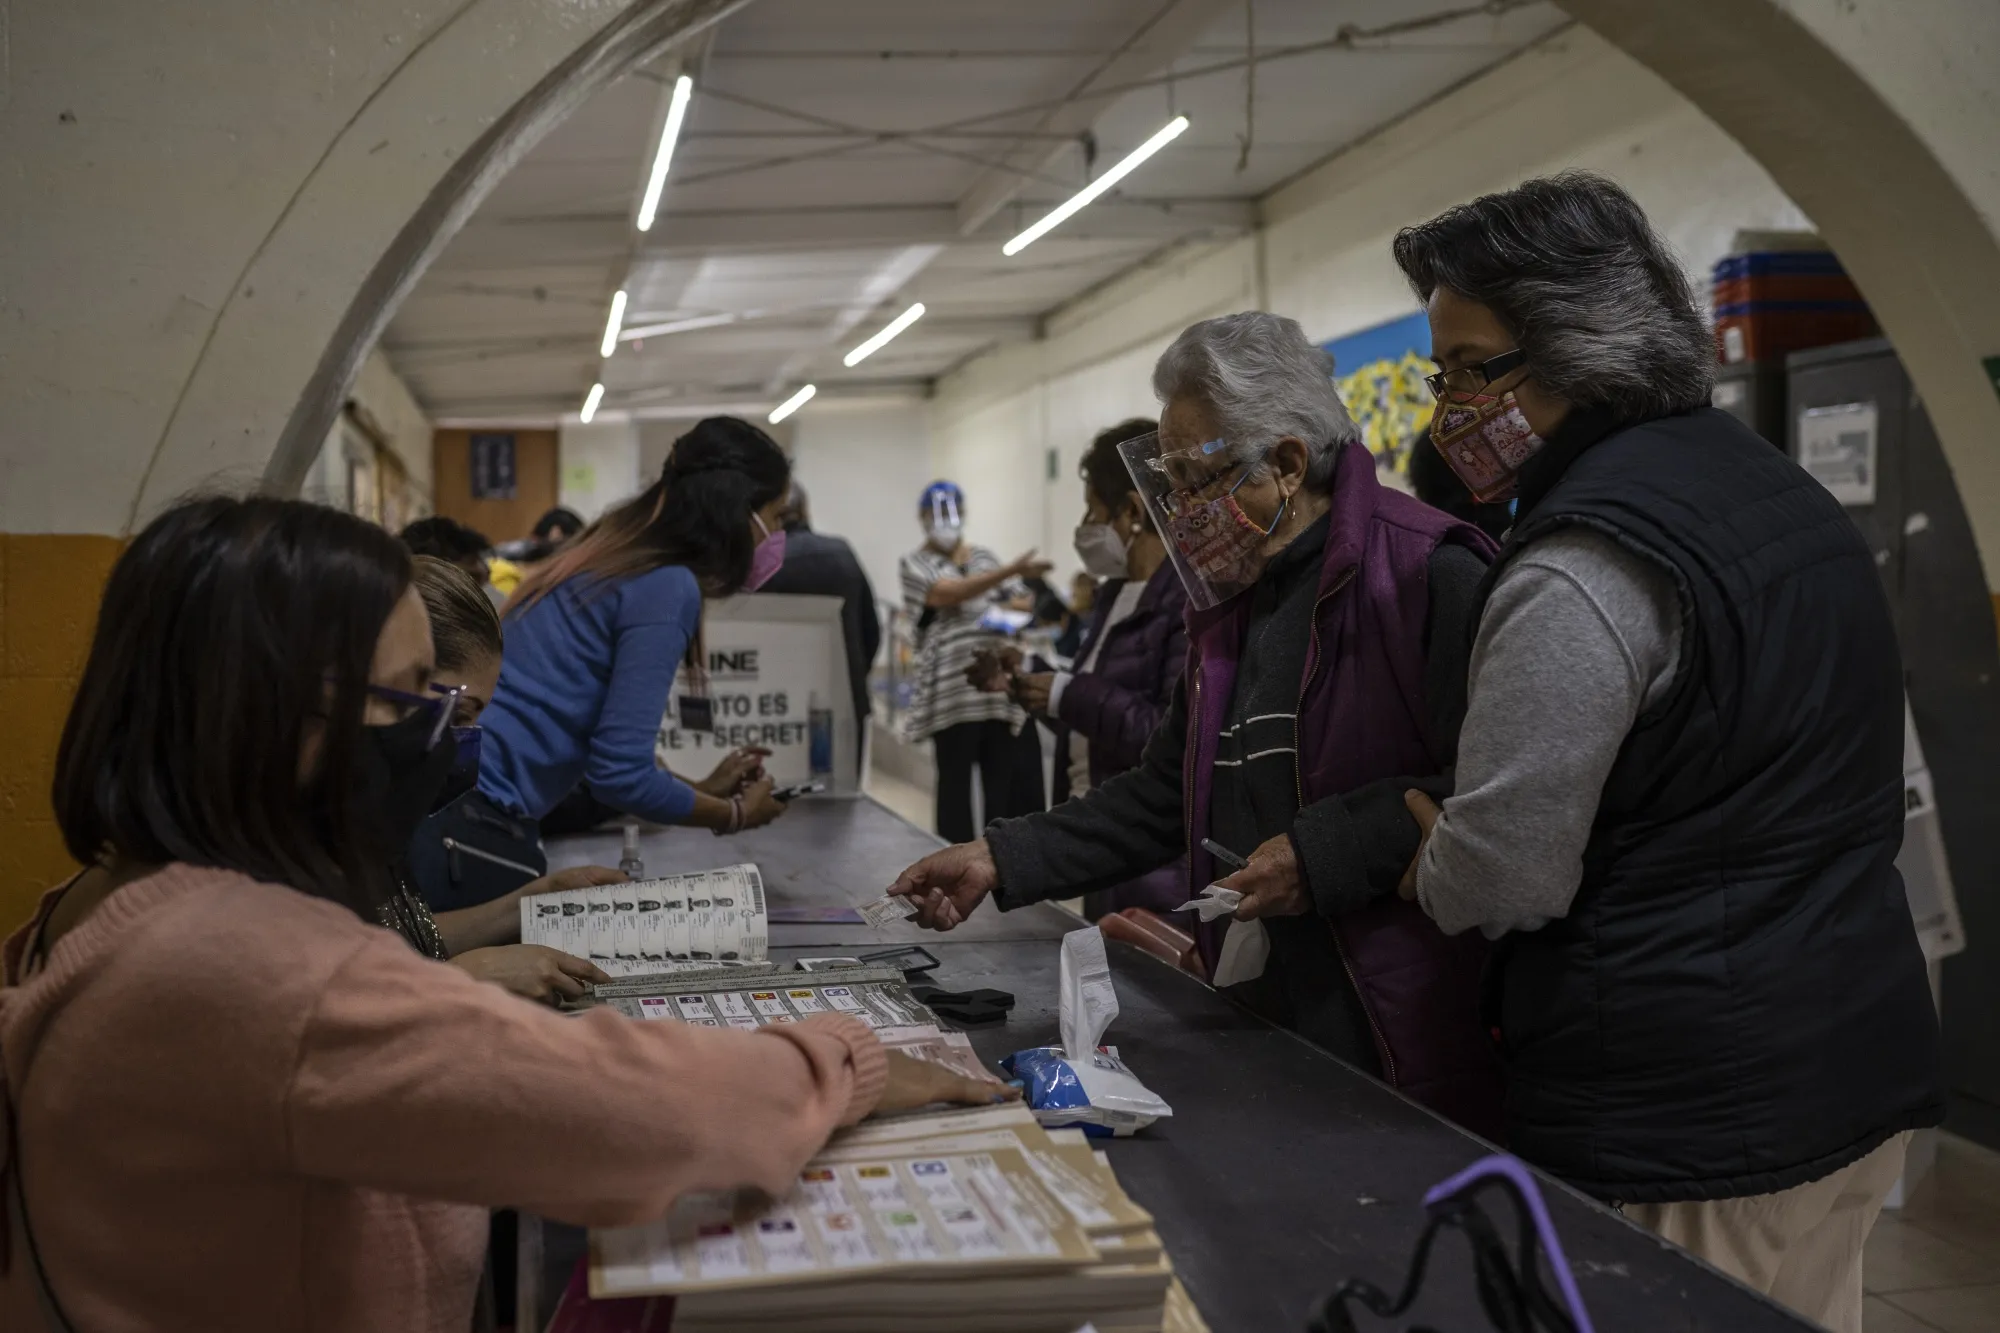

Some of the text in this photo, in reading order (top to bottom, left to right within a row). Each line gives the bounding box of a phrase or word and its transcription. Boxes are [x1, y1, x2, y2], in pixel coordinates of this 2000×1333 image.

[711, 651, 758, 672] INE
[758, 693, 788, 716] ES
[714, 724, 805, 748] SECRET
